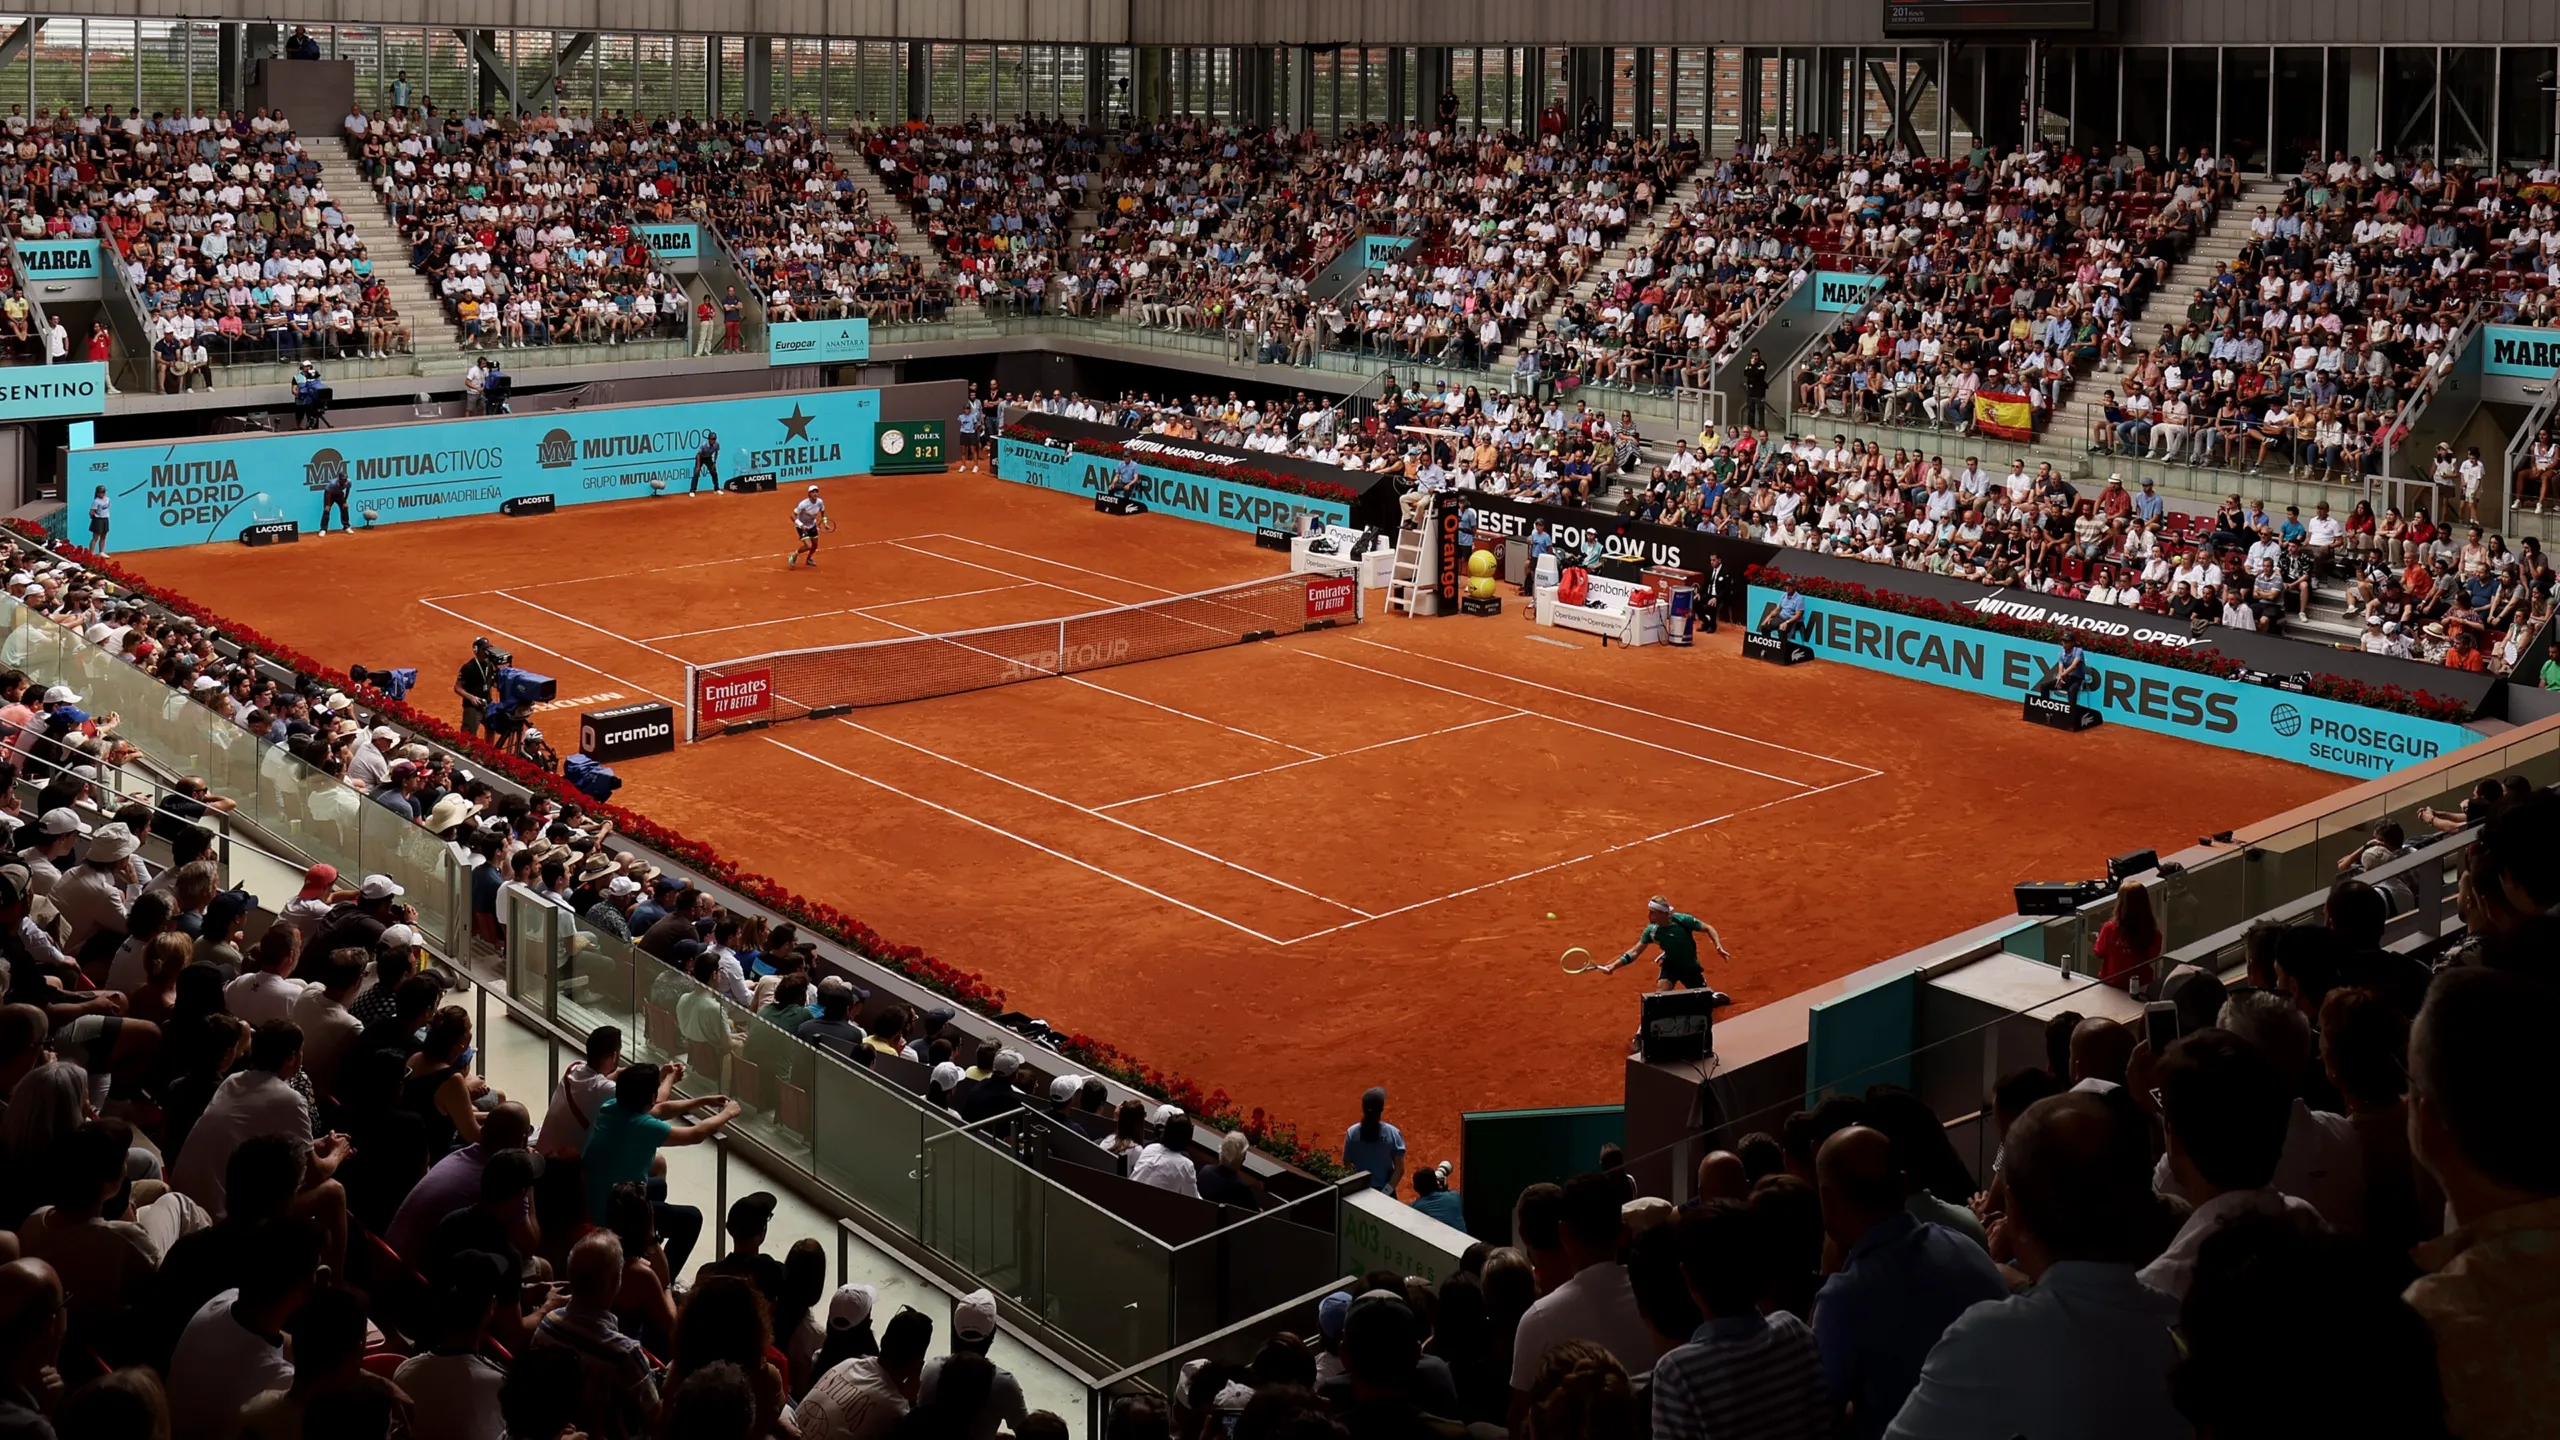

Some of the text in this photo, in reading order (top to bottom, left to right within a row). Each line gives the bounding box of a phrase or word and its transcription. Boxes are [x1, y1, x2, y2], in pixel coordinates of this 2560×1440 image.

[1893, 7, 1908, 17] 201
[20, 249, 92, 271] MARCA
[775, 340, 817, 351] Europcar
[826, 339, 865, 348] ANANTARA
[2494, 338, 2560, 368] MARC
[0, 381, 94, 401] SENTINO
[750, 443, 842, 469] ESTRELLA
[915, 446, 939, 458] 3:21
[1015, 447, 1070, 466] DUNLOP
[1123, 438, 1240, 466] MUTUA MADRID OPEN
[356, 447, 503, 480] MUTUACTIVOS
[780, 465, 813, 477] DAMM
[151, 459, 239, 488] MUTUA
[583, 474, 617, 489] GRUPO
[744, 474, 773, 483] LACOSTE
[147, 483, 244, 508] MADRID
[356, 485, 503, 513] GRUPO MUTUAMADRILEÑA
[518, 495, 551, 506] LACOSTE
[1098, 494, 1118, 504] LACOSTE
[159, 504, 230, 527] OPEN
[255, 524, 293, 534] LACOSTE
[1259, 528, 1284, 540] LACOSTE
[1441, 514, 1458, 599] Orange
[1652, 542, 1681, 568] US
[1308, 584, 1351, 602] Emirates
[1587, 582, 1630, 598] penbank
[1315, 597, 1345, 611] FLY BETTER
[1554, 610, 1581, 621] Openbank
[1587, 617, 1616, 629] Openbank
[1975, 597, 2195, 648] MUTUA MADRID OPEN
[1747, 636, 1781, 649] LACOSTE
[1063, 638, 1130, 668] TOUR
[705, 679, 767, 701] Emirates
[594, 703, 660, 717] crambo
[715, 694, 758, 713] FLY BETTER
[2029, 697, 2071, 714] LACOSTE
[604, 723, 669, 745] crambo
[2310, 717, 2440, 759] PROSEGUR
[2309, 742, 2395, 772] SECURITY
[1344, 1213, 1380, 1254] A03
[1384, 1244, 1435, 1283] pares
[815, 1368, 877, 1432] ESTUDIOS
